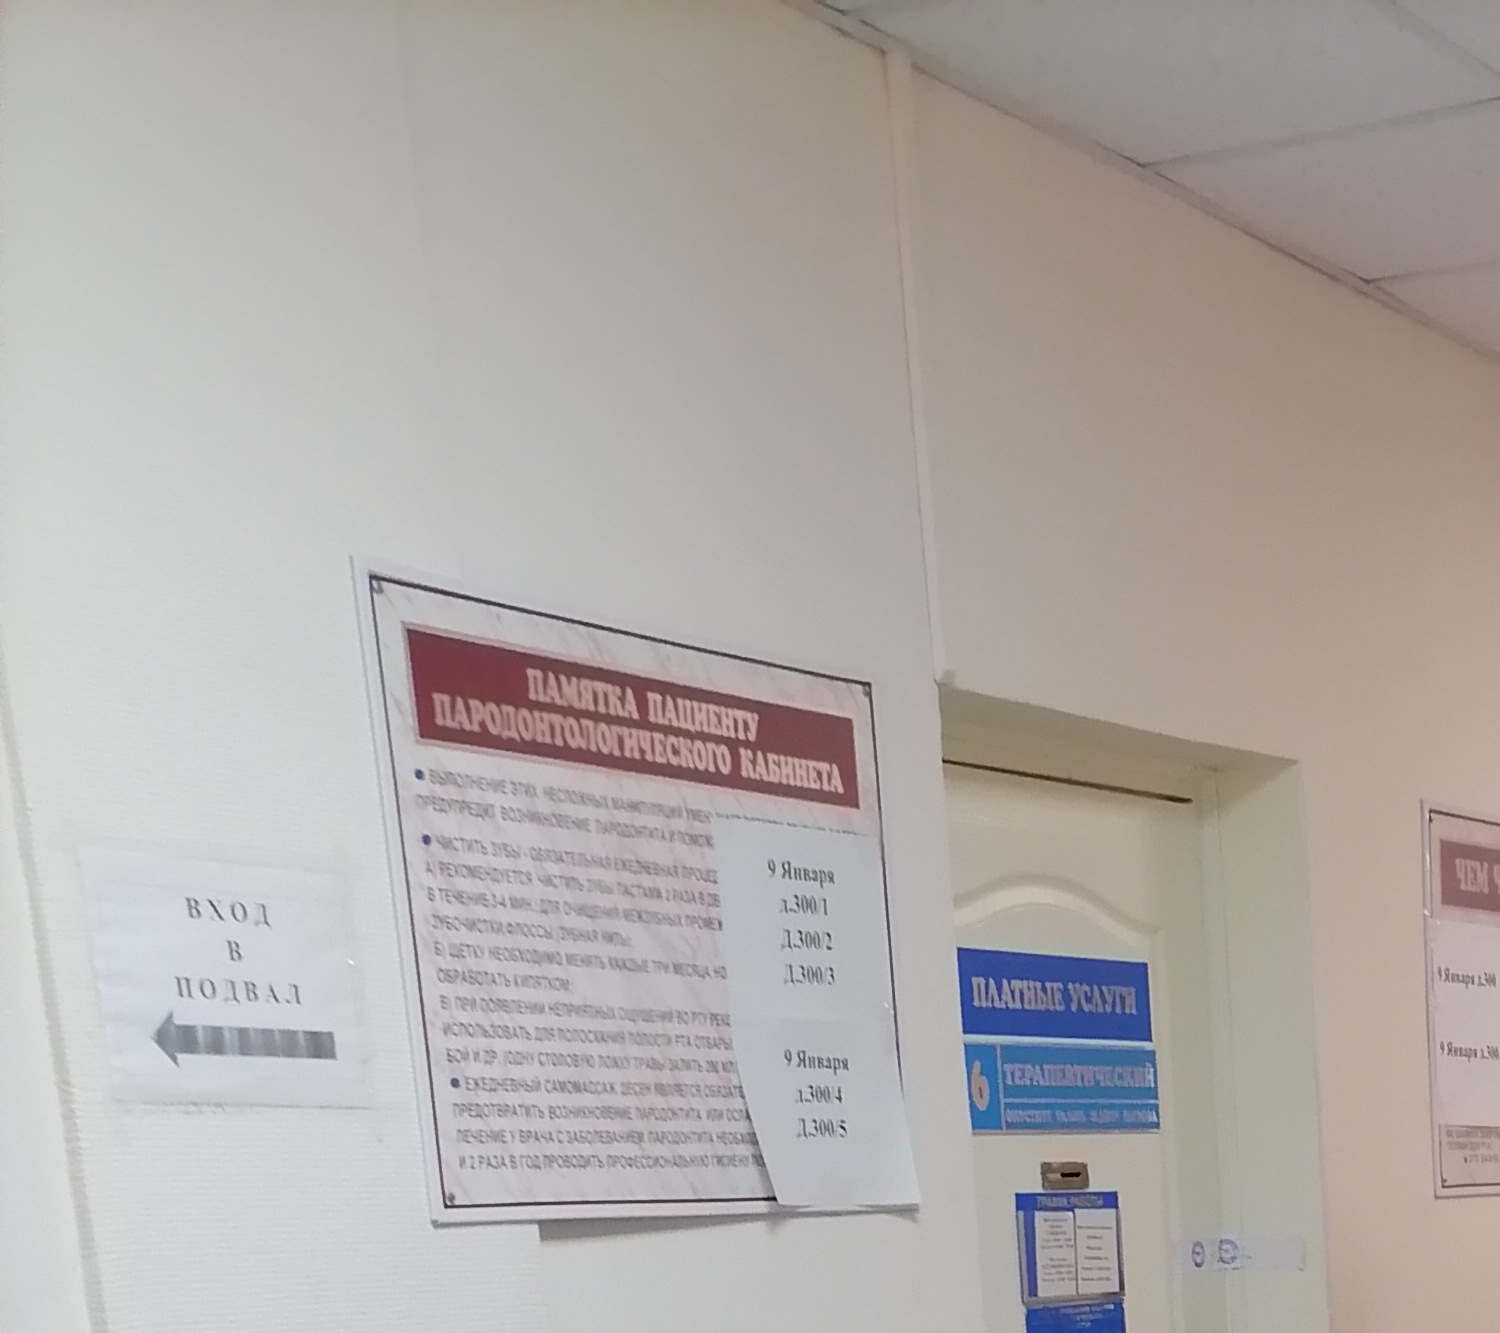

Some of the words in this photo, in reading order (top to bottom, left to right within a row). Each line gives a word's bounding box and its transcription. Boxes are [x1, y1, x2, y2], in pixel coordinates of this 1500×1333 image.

[525, 667, 638, 720] ПАМЯТКА
[647, 692, 760, 744] ПАЦИЕНТУ
[431, 692, 732, 777] ПАРОДОНТОЛОГИЧЕСКОГО
[740, 747, 845, 794] КАБИНЕТА
[767, 859, 776, 878] 9
[781, 860, 836, 889] Января
[1455, 857, 1490, 893] ЧЕМ
[184, 896, 271, 930] ВХОД
[226, 939, 244, 963] В
[781, 929, 833, 952] Д.300/2
[784, 963, 835, 986] Д.300/3
[1438, 966, 1443, 979] 9
[1444, 968, 1475, 990] Января
[174, 976, 302, 1007] ПОДВАЛ
[971, 976, 1065, 1013] ПЛАТНЫЕ
[1067, 982, 1138, 1015] УСЛУГИ
[784, 1049, 793, 1068] 9
[797, 1050, 850, 1076] Января
[1440, 1040, 1445, 1056] 9
[1446, 1041, 1478, 1063] Января
[971, 1059, 990, 1111] 6
[1003, 1062, 1156, 1089] ТЕРАПЕВТИЧЕСКИЙ
[797, 1117, 848, 1140] Д.300/5
